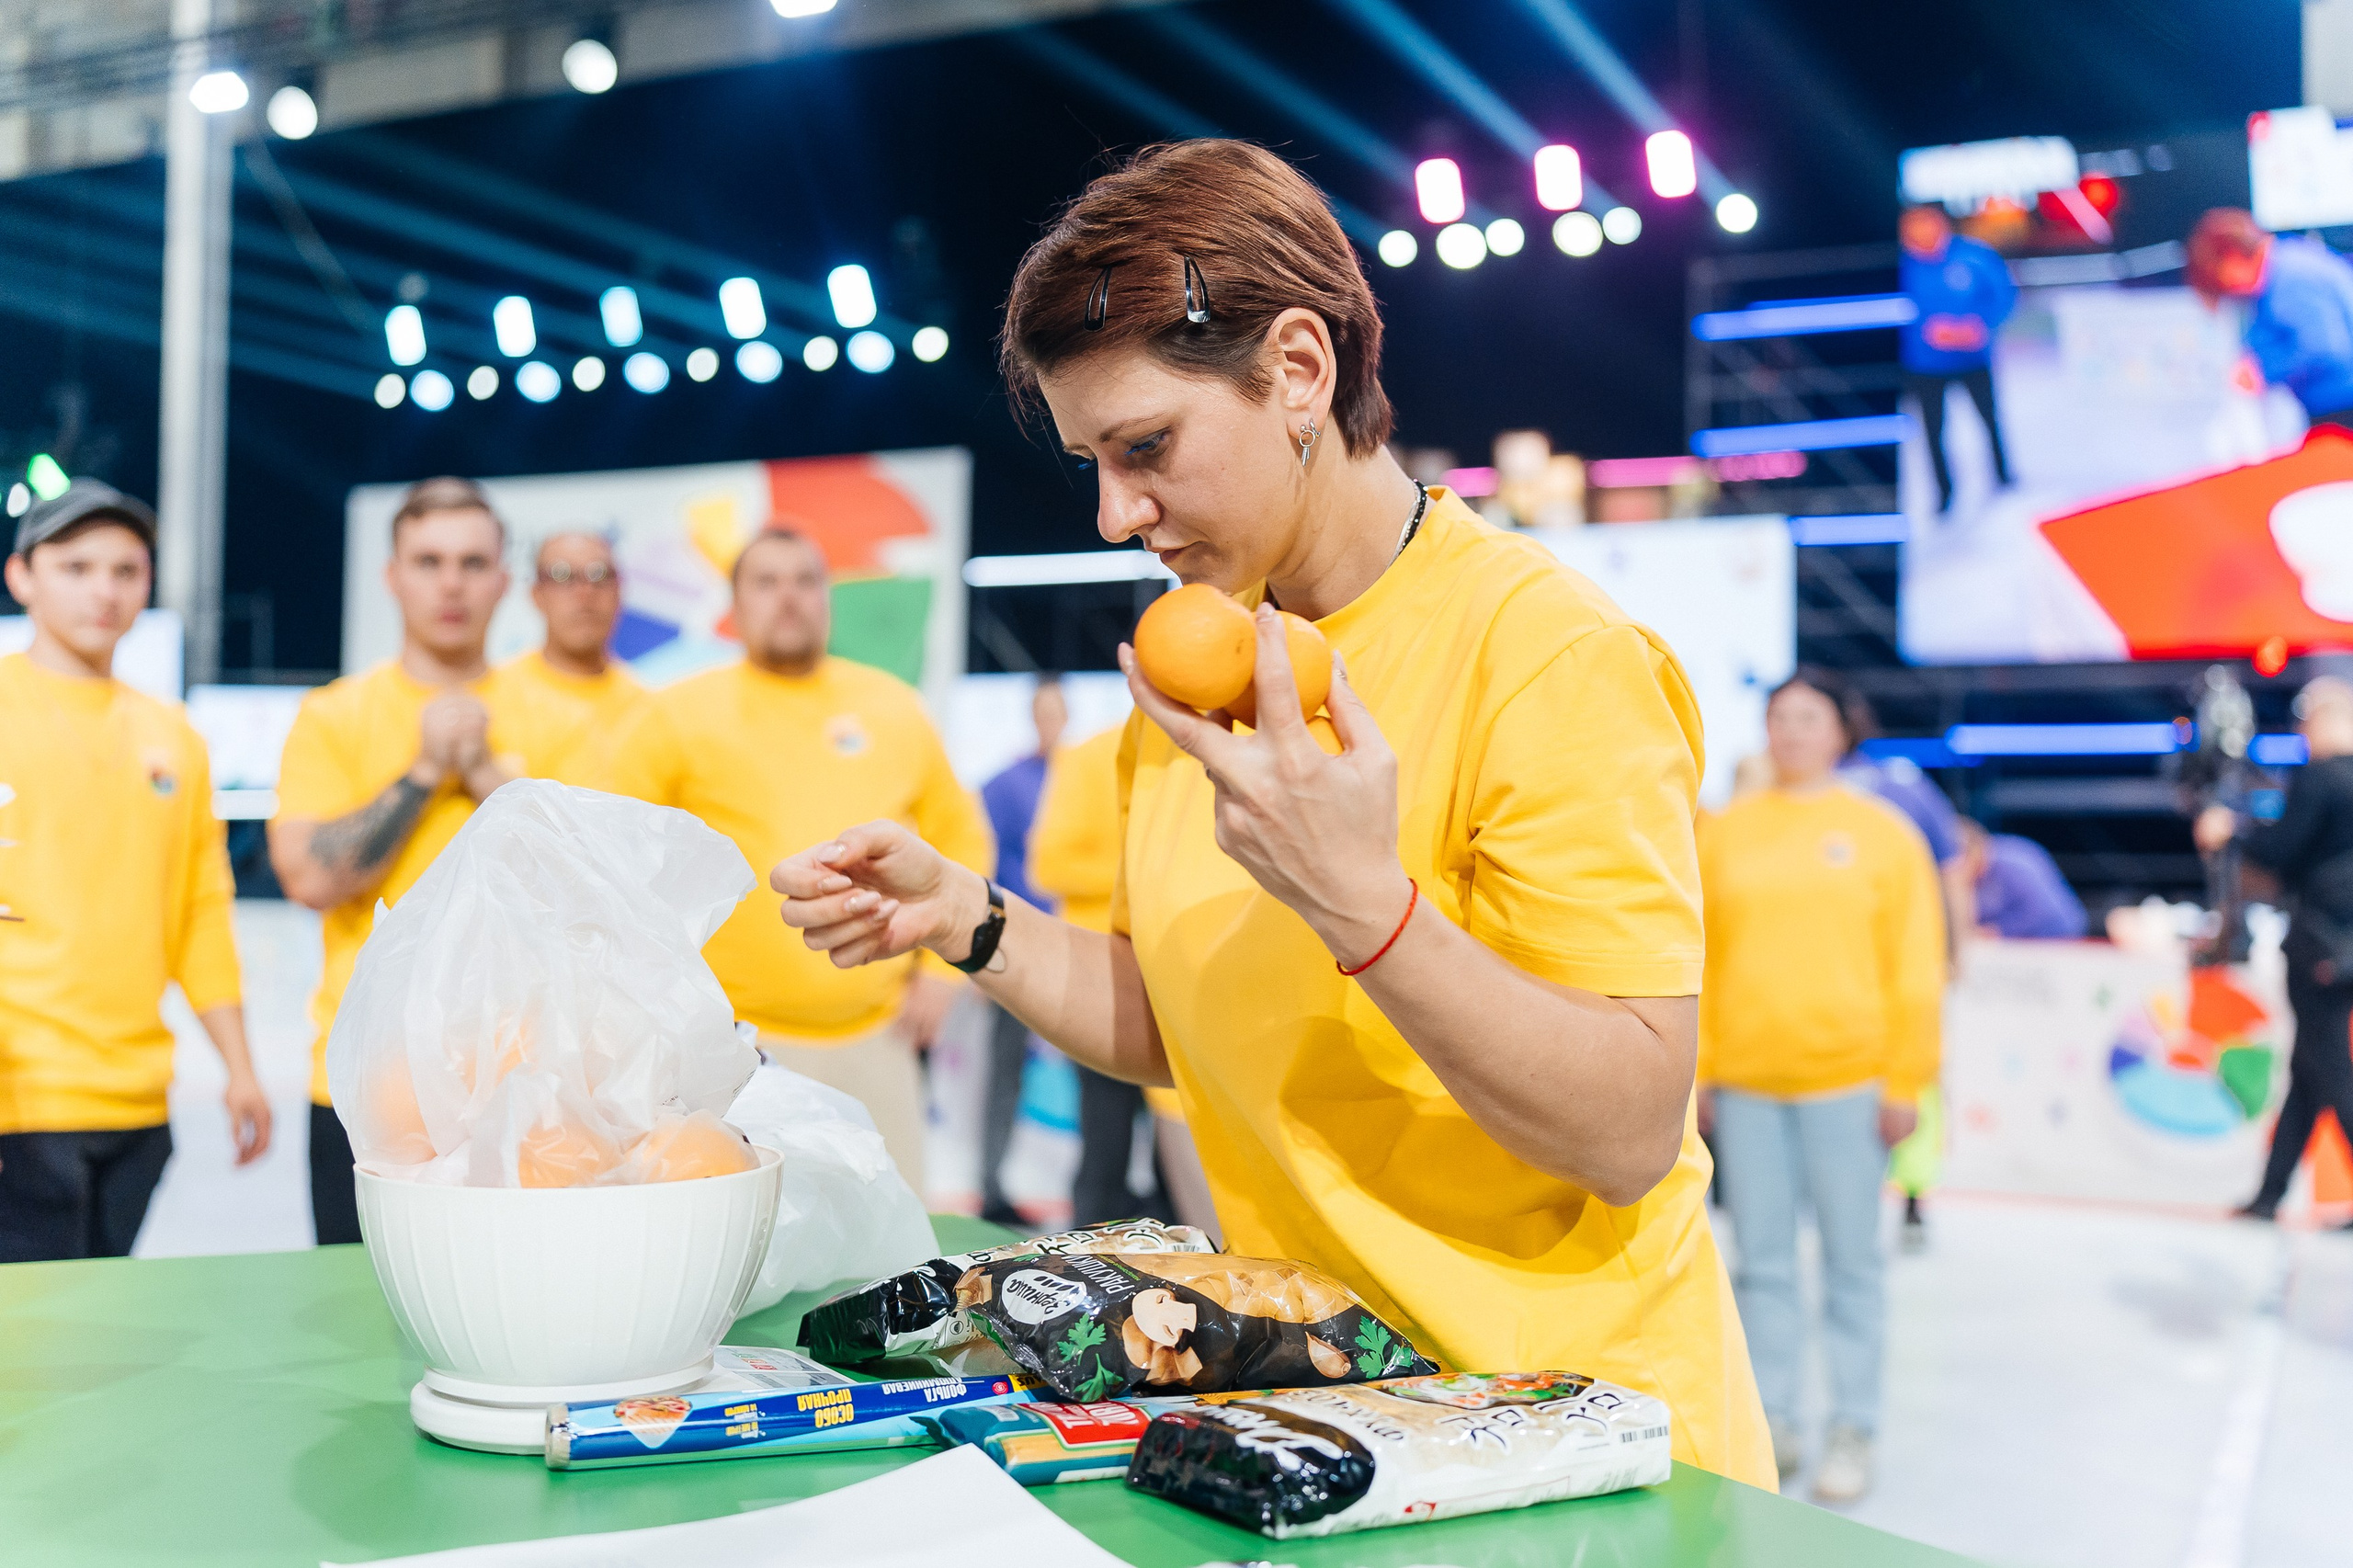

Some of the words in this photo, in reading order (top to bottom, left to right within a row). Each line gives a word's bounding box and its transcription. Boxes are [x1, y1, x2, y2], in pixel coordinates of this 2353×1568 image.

[796, 1389, 852, 1412] ПРОЧНАЯ
[924, 1383, 967, 1403] ФОЛЬГА
[815, 1406, 854, 1427] ОСОБО
